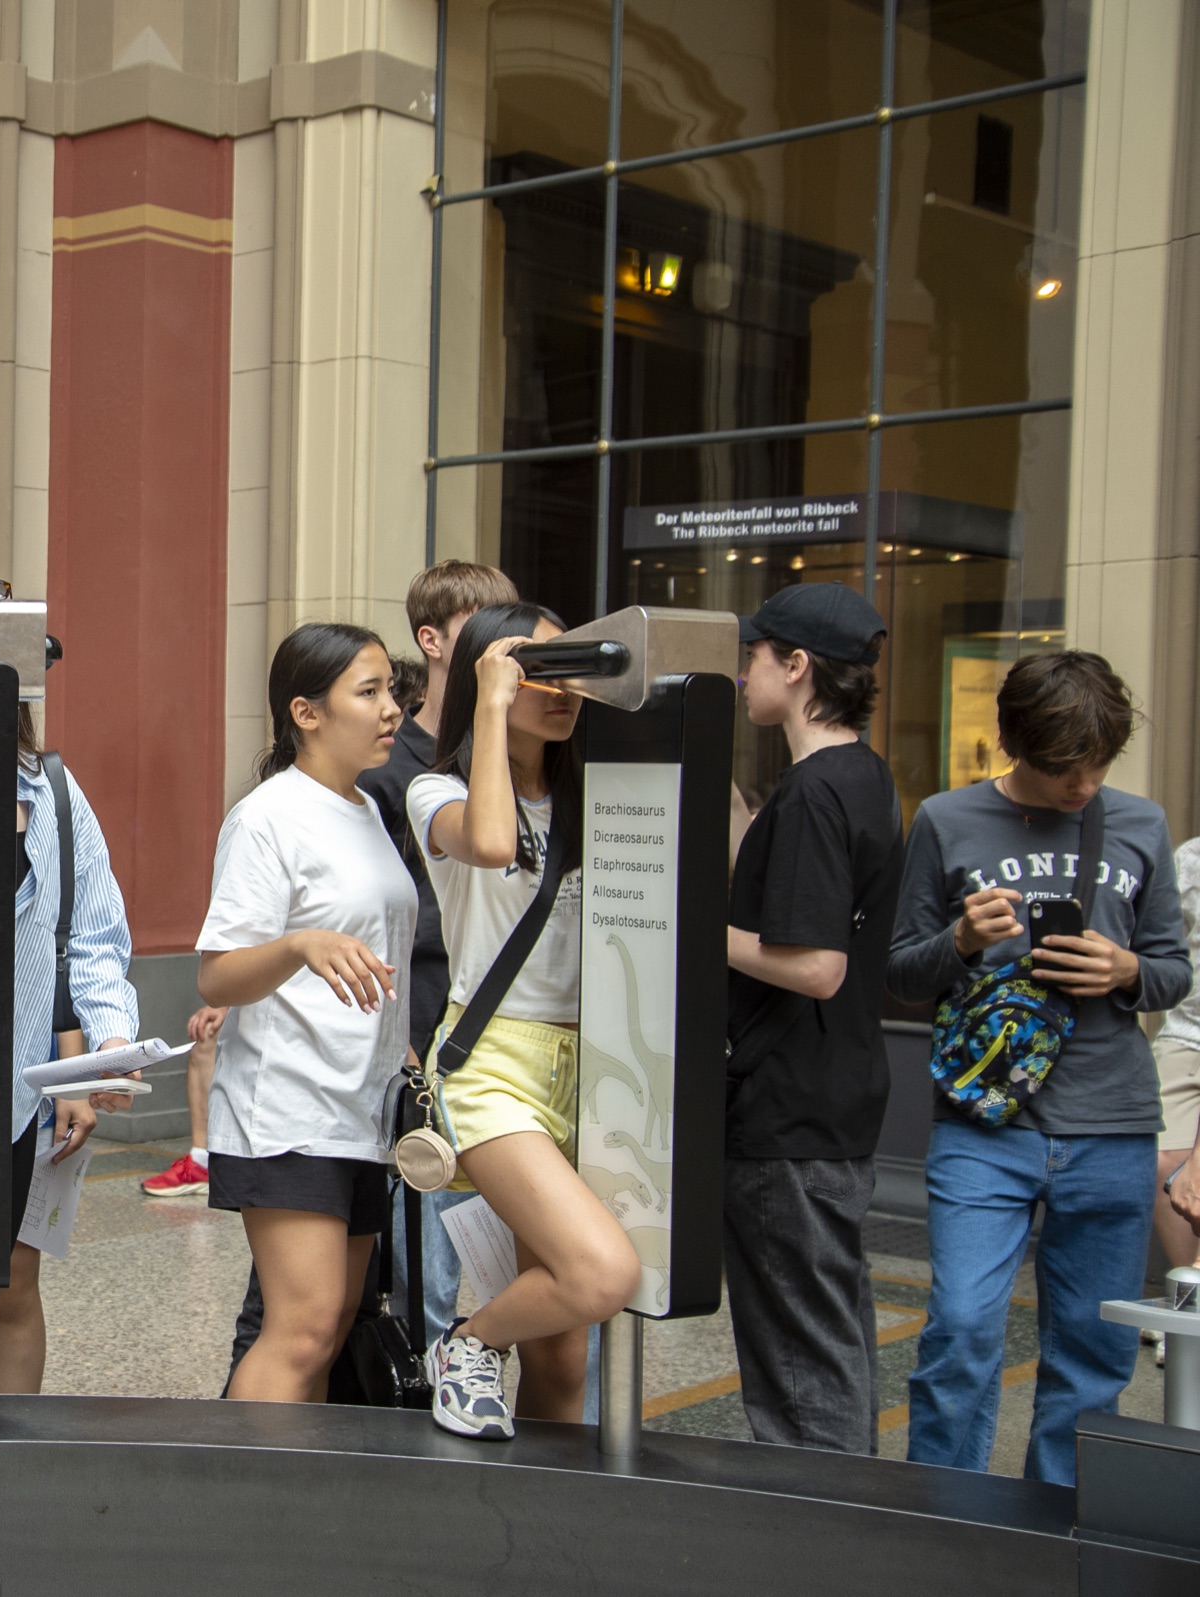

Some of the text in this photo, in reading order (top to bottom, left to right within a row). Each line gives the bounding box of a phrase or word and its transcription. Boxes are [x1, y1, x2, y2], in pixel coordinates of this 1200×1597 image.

[656, 501, 858, 526] Der Meteoritenfall von Ribbeck
[672, 517, 840, 539] The Ribbeck meteorite fall
[594, 803, 665, 817] Brachiosaurus
[594, 830, 664, 845] Dicraeosaurus
[593, 857, 664, 873] Elaphrosaurus
[592, 885, 644, 900] Allosaurus
[592, 912, 667, 930] Dysalotosaurus
